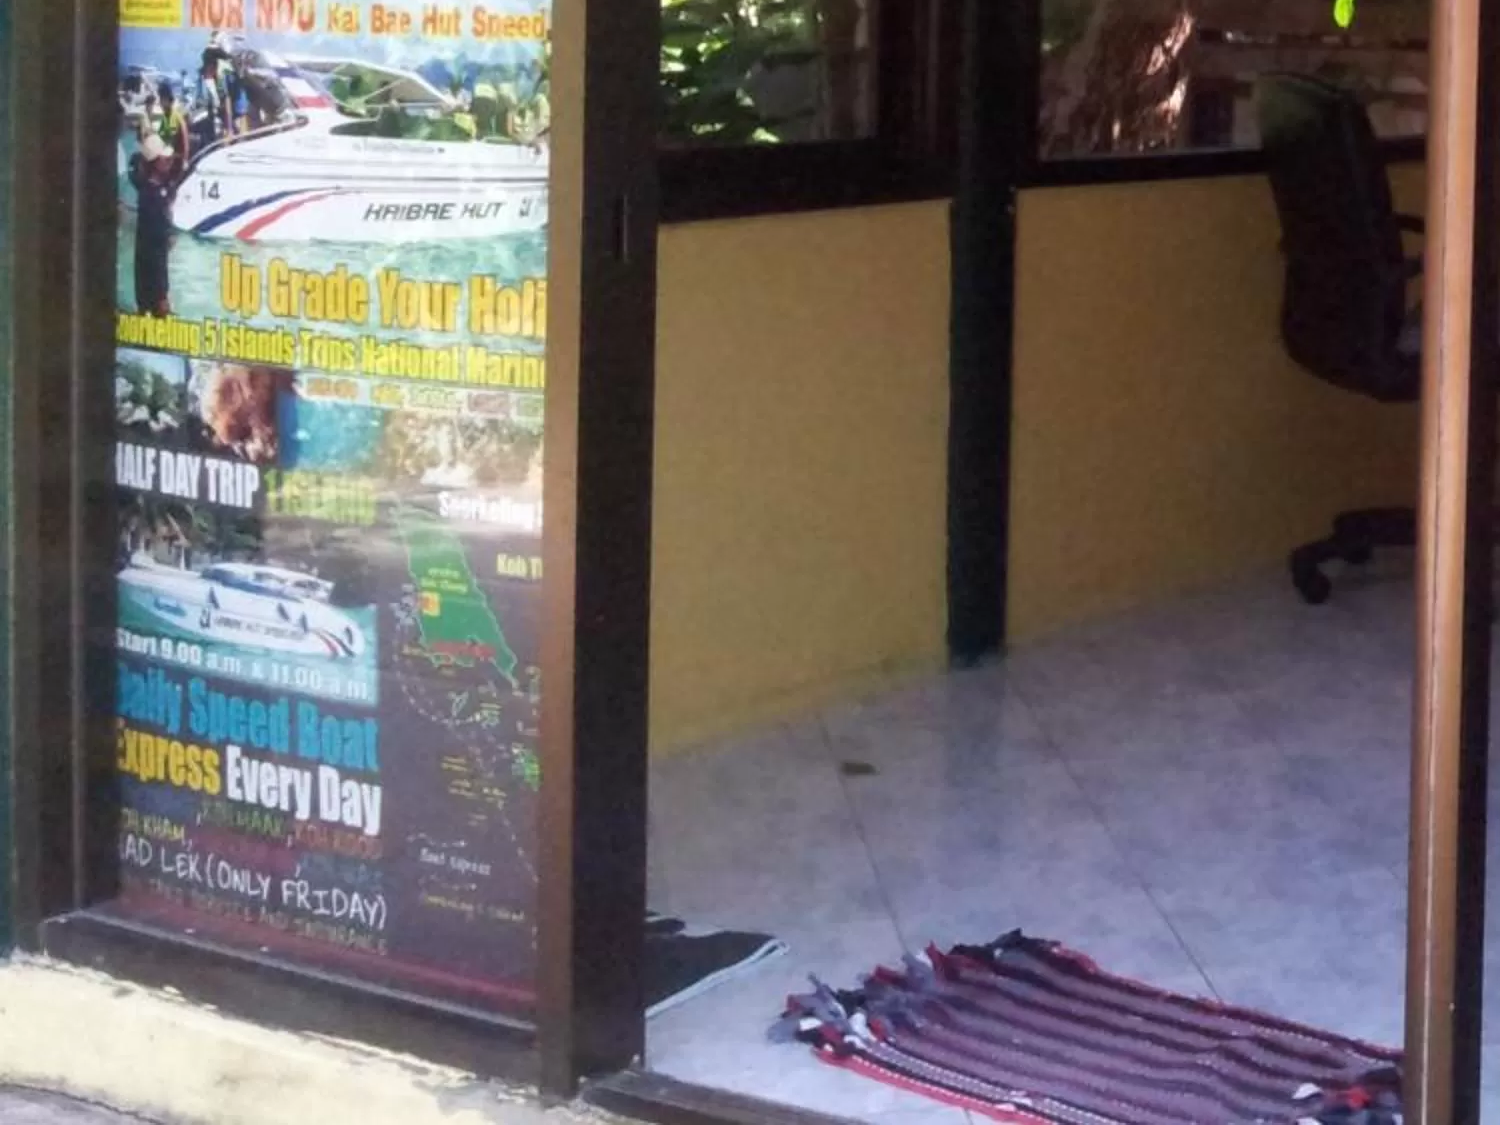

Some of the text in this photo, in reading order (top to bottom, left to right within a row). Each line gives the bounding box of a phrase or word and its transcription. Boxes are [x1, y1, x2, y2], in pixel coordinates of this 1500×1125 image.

[327, 3, 360, 33] Kai
[370, 6, 412, 34] Bae
[422, 6, 462, 35] Hut
[198, 180, 220, 202] 14
[220, 253, 262, 317] Up
[267, 258, 370, 325] Grade
[379, 268, 462, 334] Your
[203, 318, 219, 352] 5
[221, 321, 294, 367] Islands
[300, 330, 357, 373] Trips
[361, 335, 460, 382] National
[159, 448, 201, 500] DAY
[205, 459, 260, 509] TRIP
[159, 633, 203, 666] 9.00
[187, 677, 291, 754] Speed
[299, 701, 380, 772] Boat
[116, 720, 222, 795] xpress
[226, 745, 312, 821] Every
[318, 764, 383, 837] Day
[281, 878, 388, 931] FRIDAY)
